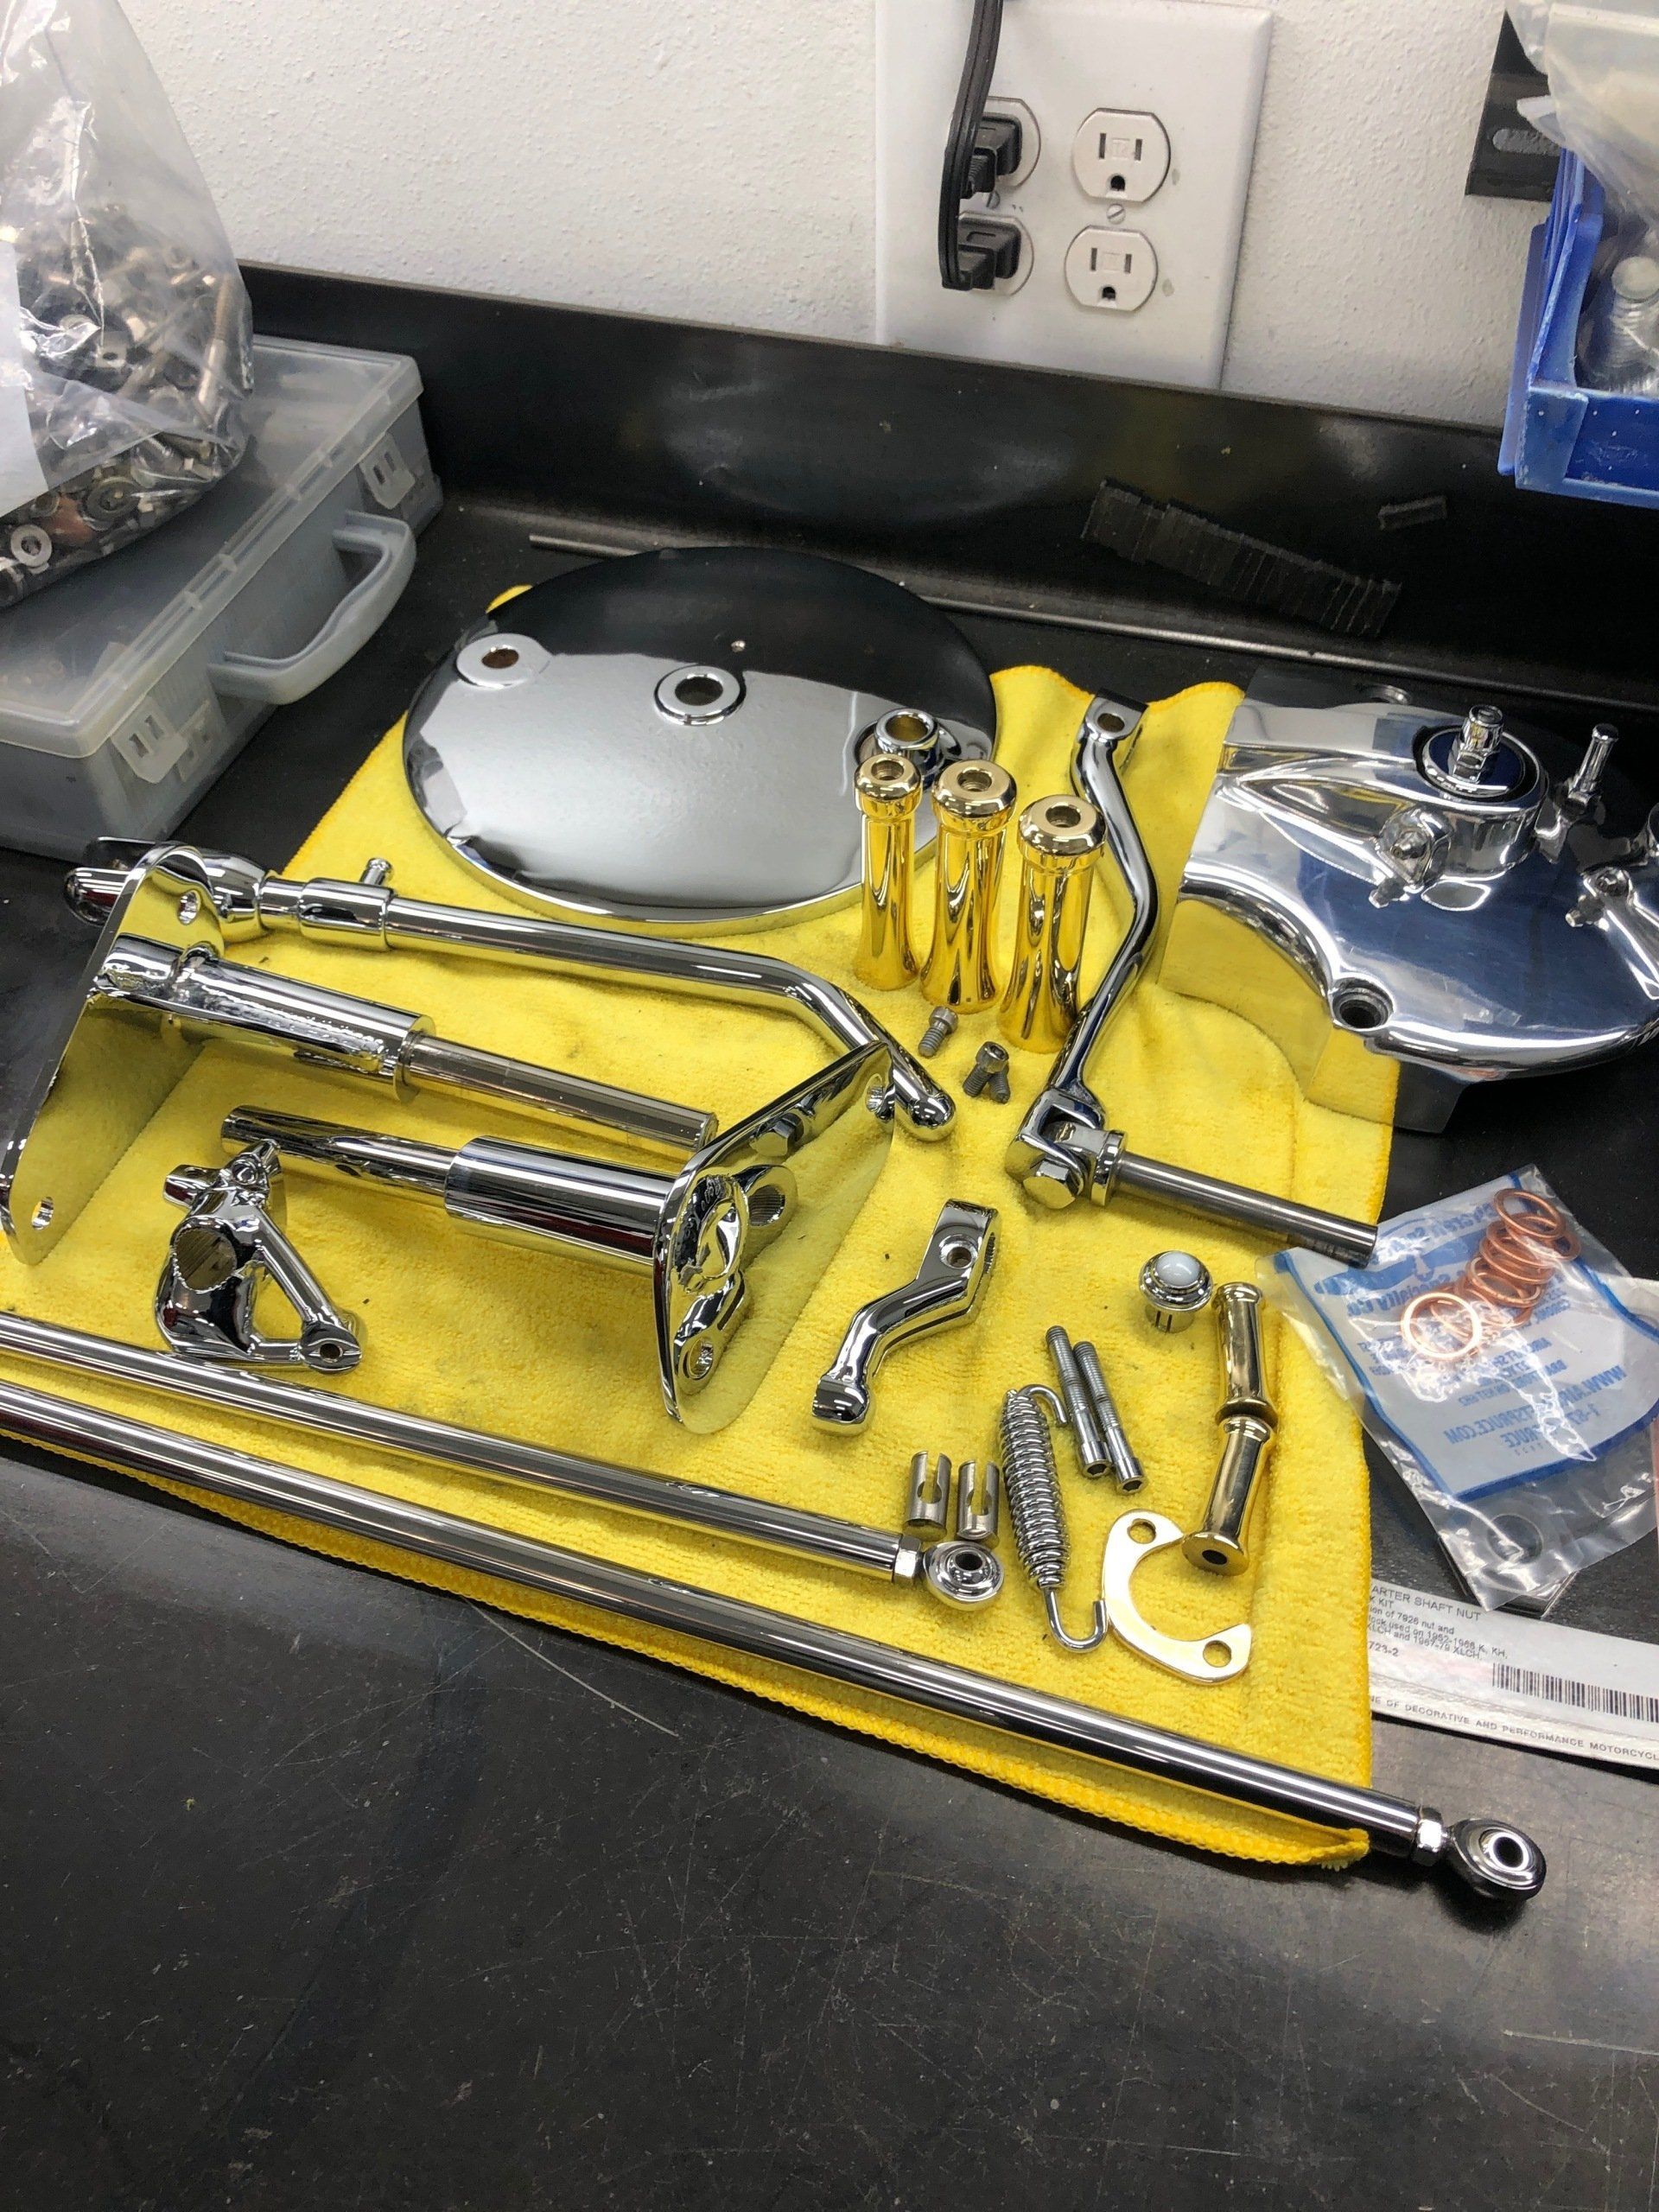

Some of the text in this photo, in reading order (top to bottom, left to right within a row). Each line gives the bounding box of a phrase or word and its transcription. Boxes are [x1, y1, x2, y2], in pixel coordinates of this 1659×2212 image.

[1378, 1598, 1394, 1609] KIT
[1414, 1597, 1453, 1614] SHAFT
[1456, 1607, 1482, 1621] NUT
[1385, 1609, 1395, 1618] of
[1421, 1620, 1435, 1630] nut
[1438, 1624, 1455, 1635] and
[1389, 1621, 1410, 1632] used
[1394, 1630, 1410, 1642] and
[1405, 1705, 1470, 1725] DECORATIVE
[1475, 1719, 1497, 1731] AND
[1502, 1724, 1584, 1748] PERFORMANCE
